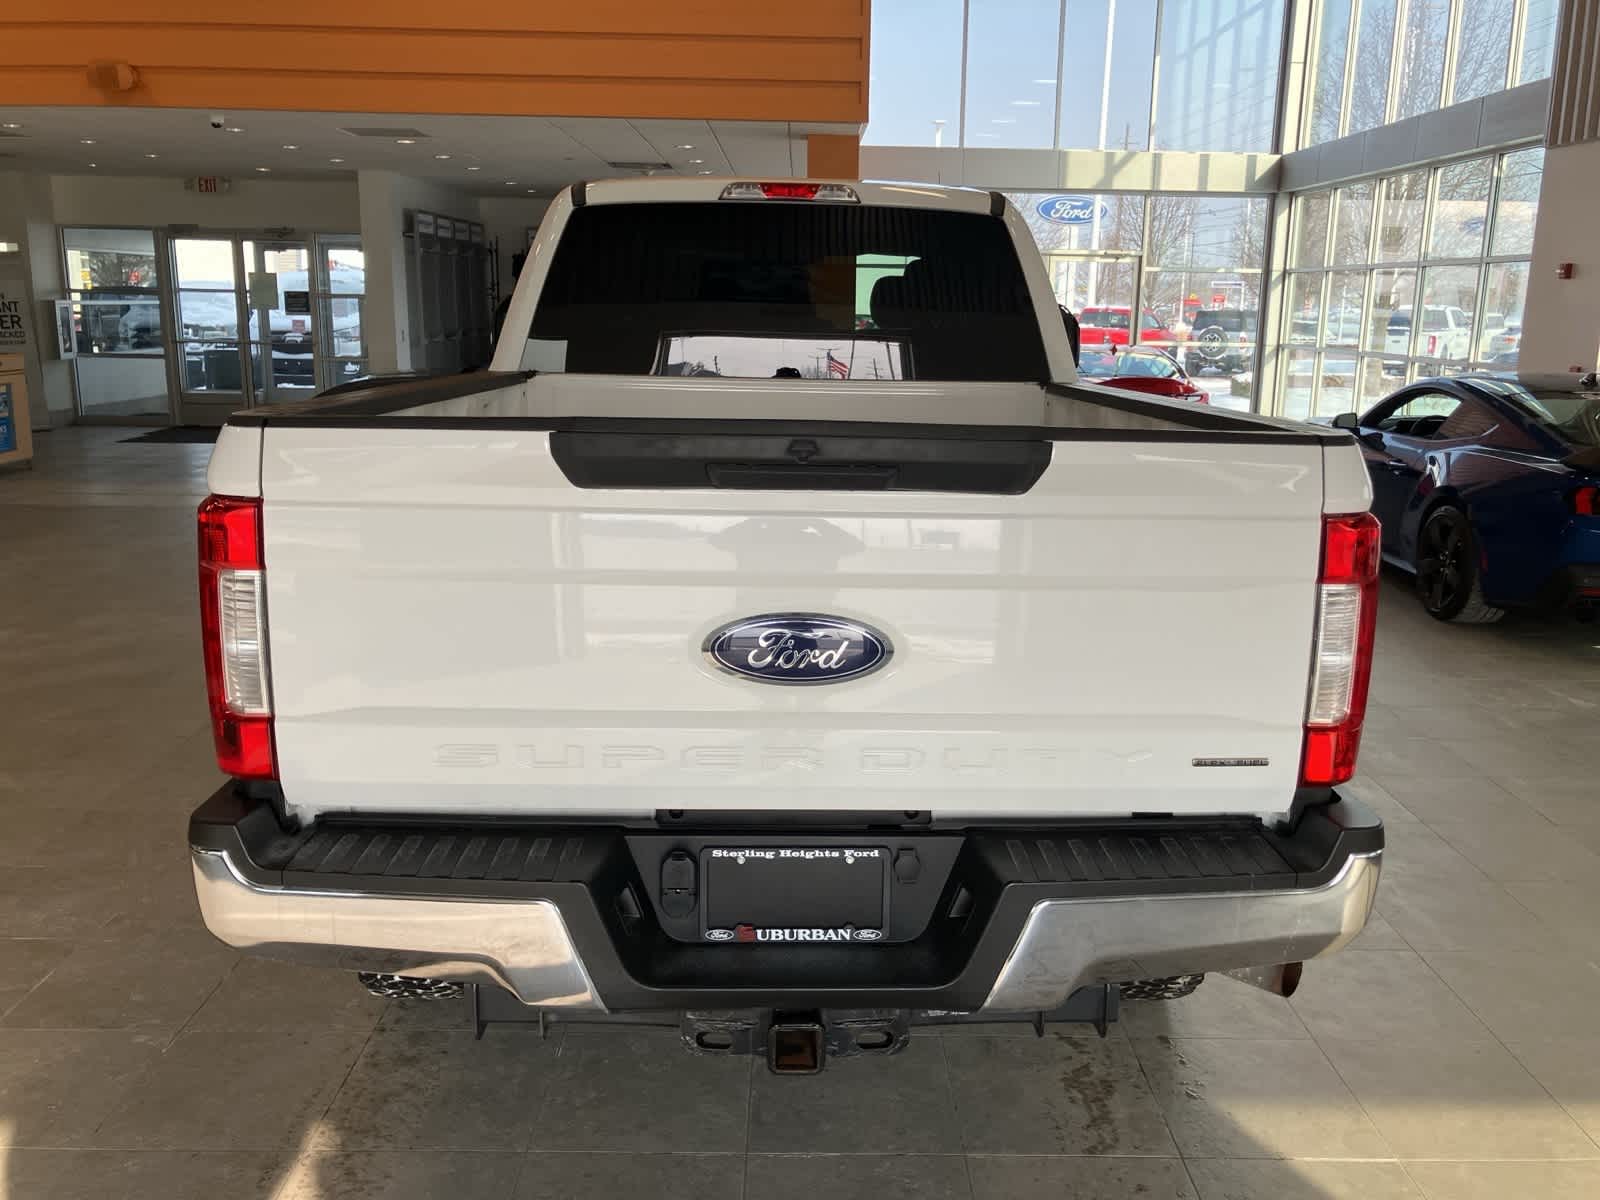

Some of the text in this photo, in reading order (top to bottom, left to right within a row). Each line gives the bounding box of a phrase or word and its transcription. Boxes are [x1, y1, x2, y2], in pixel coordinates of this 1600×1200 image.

[198, 176, 217, 193] EXIT
[1050, 199, 1094, 219] Ford
[747, 628, 850, 669] Ford
[431, 742, 1155, 776] SUPER DUTY
[711, 849, 880, 859] Sterling Heights Ford
[736, 925, 851, 942] SUBURBAN
